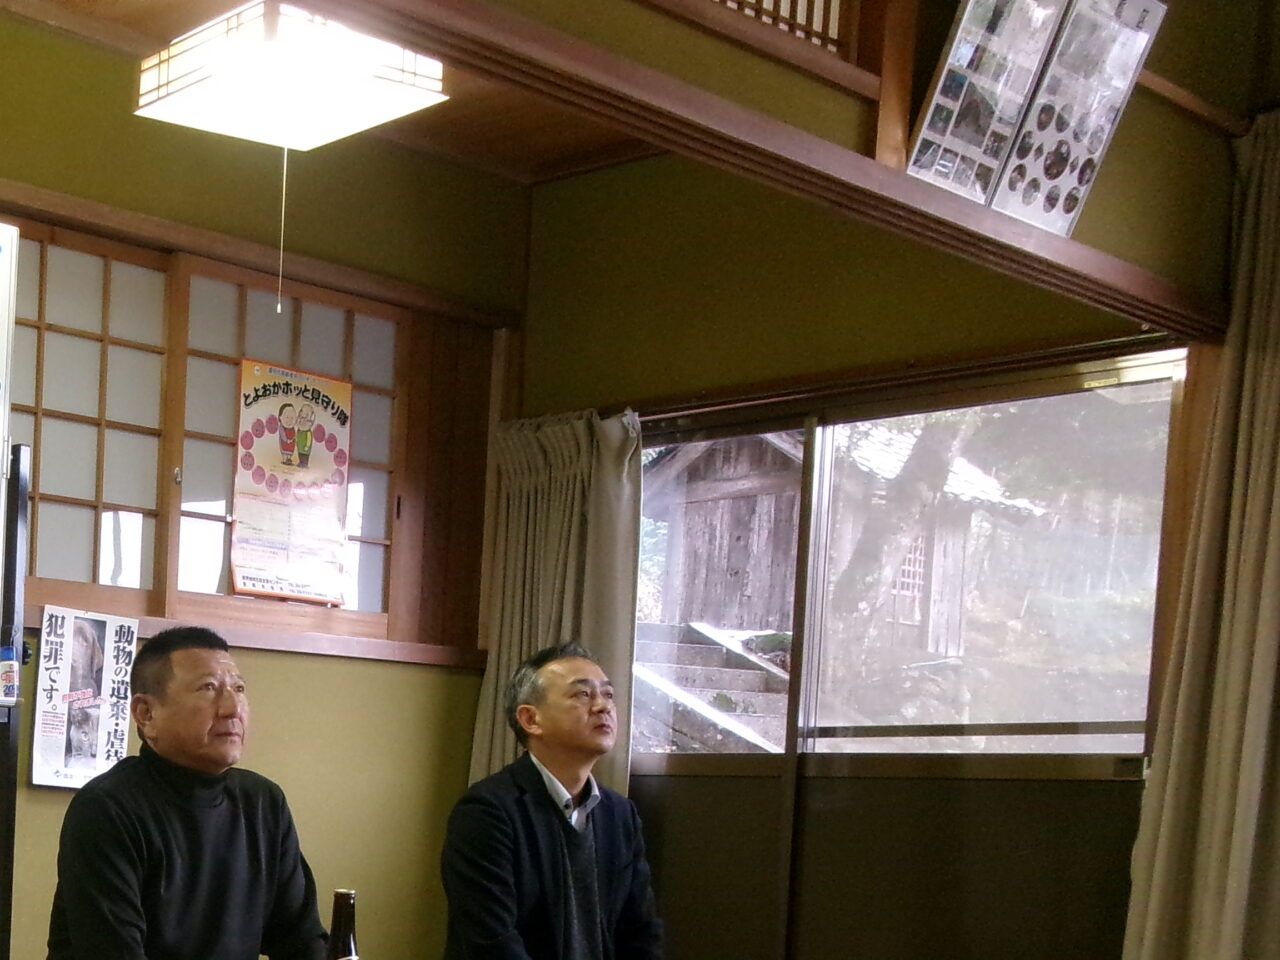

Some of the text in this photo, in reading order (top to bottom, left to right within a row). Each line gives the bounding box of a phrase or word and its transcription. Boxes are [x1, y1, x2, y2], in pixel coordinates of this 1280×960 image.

[243, 381, 349, 426] とよおかホッと見守り隊
[41, 612, 67, 711] 犯罪です。
